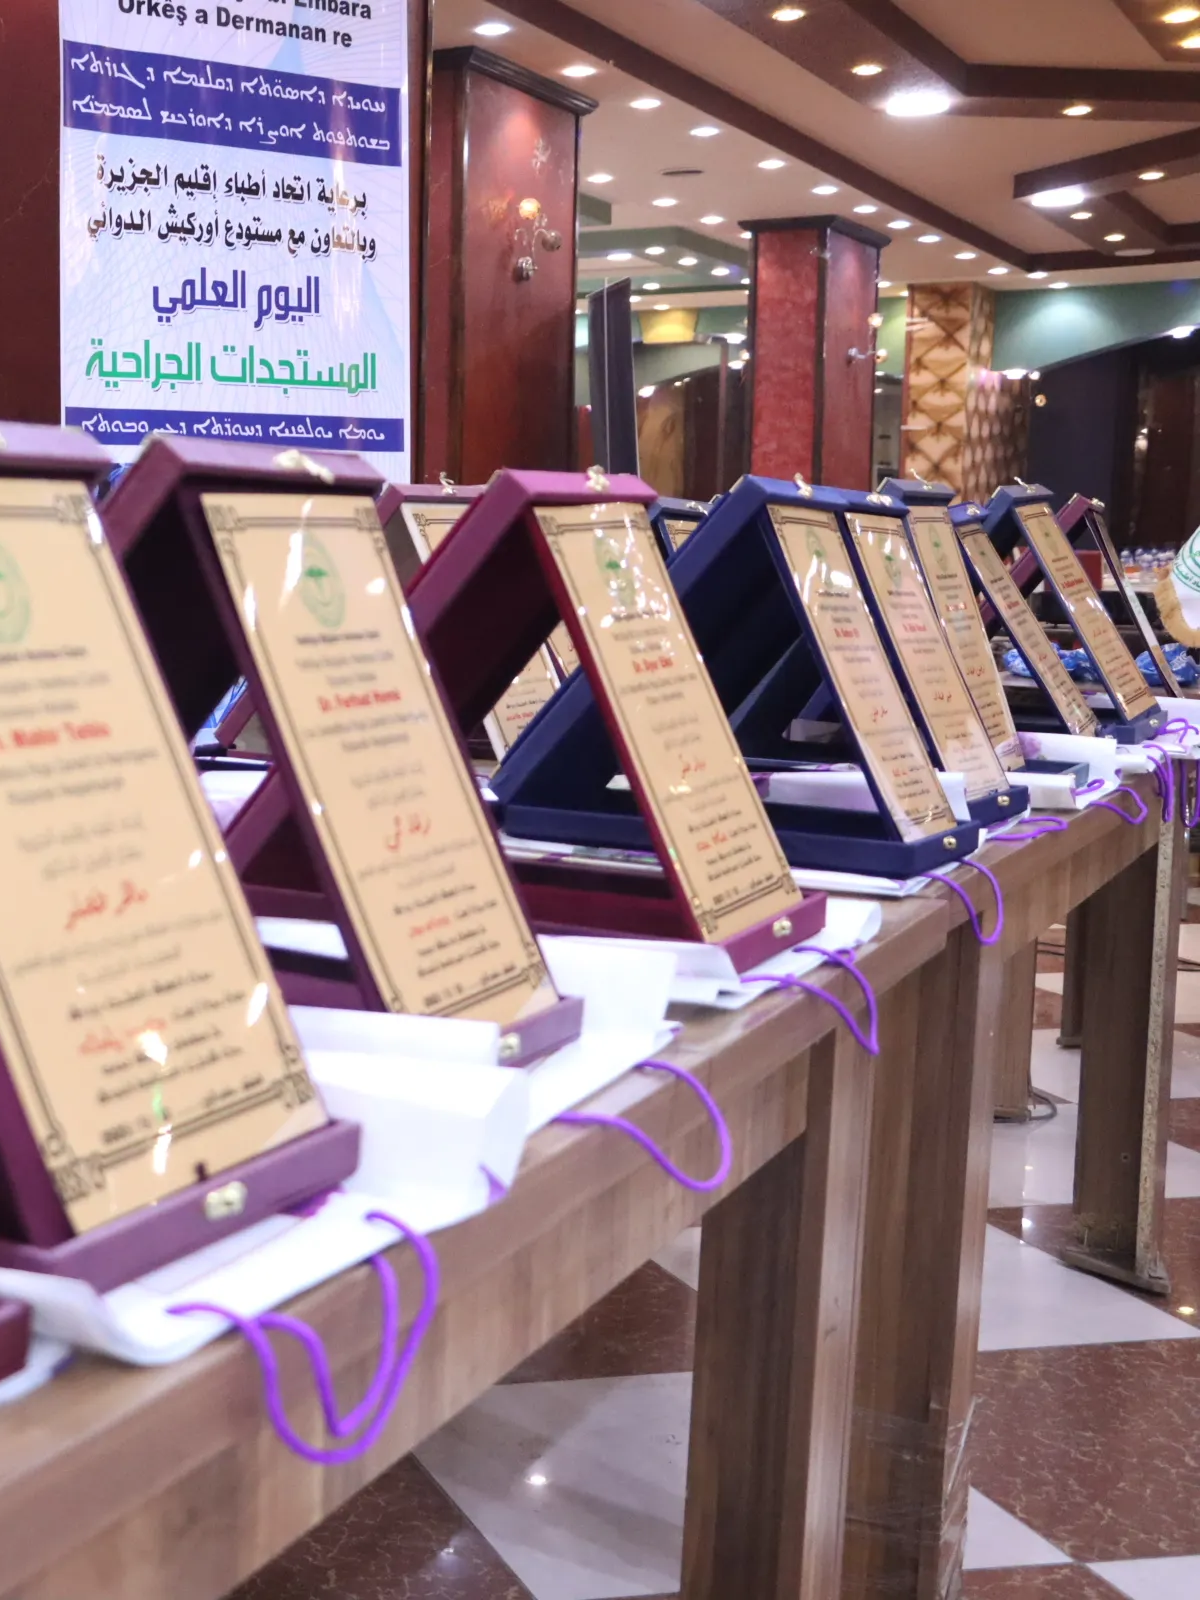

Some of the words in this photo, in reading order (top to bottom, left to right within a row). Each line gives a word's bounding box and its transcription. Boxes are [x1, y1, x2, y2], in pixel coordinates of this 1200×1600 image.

[195, 11, 208, 25] a
[216, 6, 326, 44] Dermanan
[332, 31, 353, 48] re
[95, 154, 168, 193] الجزيرة
[173, 163, 218, 202] إقليم
[223, 169, 267, 201] أطباء
[272, 174, 311, 202] اتحاد
[317, 176, 368, 217] برعاية
[157, 203, 219, 243] أوركيش
[224, 215, 282, 247] مستودع
[287, 227, 305, 254] مع
[310, 224, 376, 261] وبالتعاون
[152, 266, 247, 324] العلمي
[254, 275, 320, 329] اليوم
[85, 338, 202, 390] الجراحية
[210, 344, 377, 395] المستجدات
